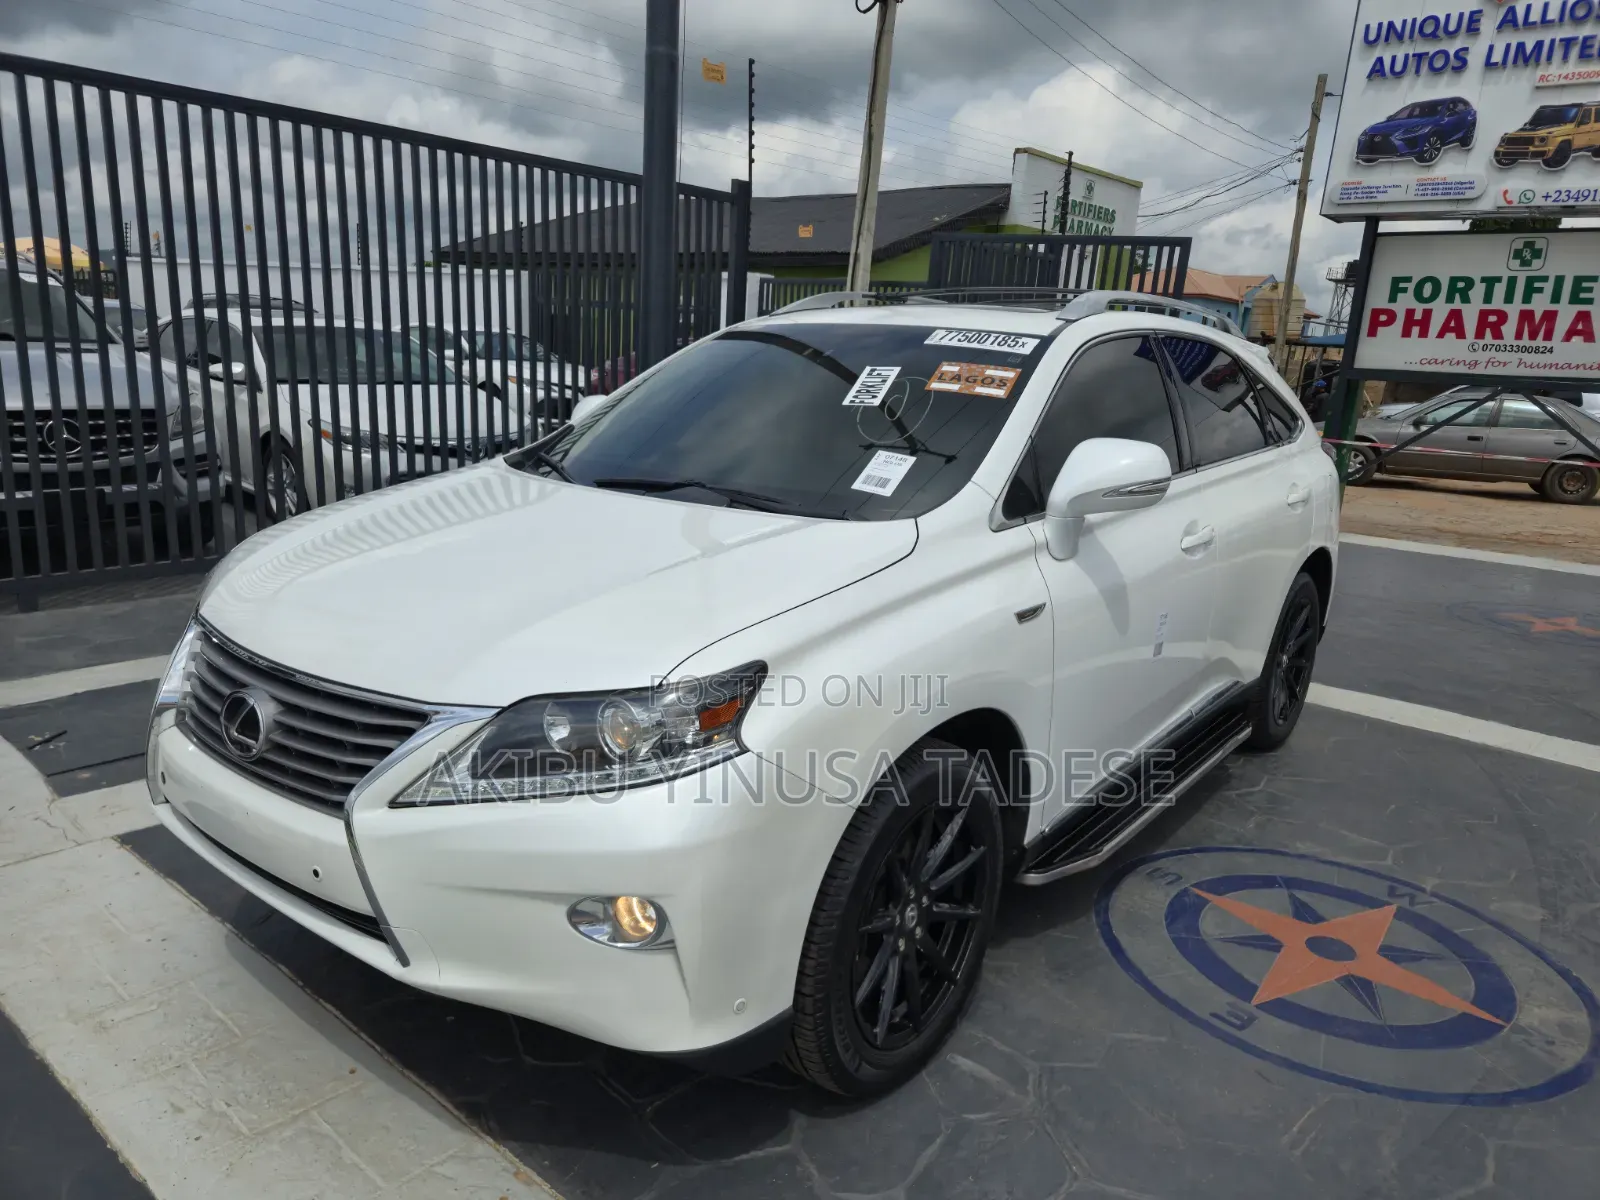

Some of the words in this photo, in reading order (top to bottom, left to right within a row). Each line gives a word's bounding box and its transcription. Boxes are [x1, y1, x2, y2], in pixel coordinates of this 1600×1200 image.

[1363, 9, 1483, 46] UNIQUE
[1496, 0, 1600, 31] ALLIO
[1366, 46, 1469, 79] AUTOS
[1484, 34, 1600, 68] LIMITE
[1542, 188, 1600, 203] +23491
[1055, 195, 1116, 223] FRTIFIERS
[1051, 215, 1114, 236] PARMACY
[1367, 307, 1597, 343] PHARMA
[1481, 343, 1554, 355] 07033300824
[1484, 357, 1512, 369] for
[849, 368, 895, 404] FORKLIFT
[937, 372, 1009, 388] LAGOS
